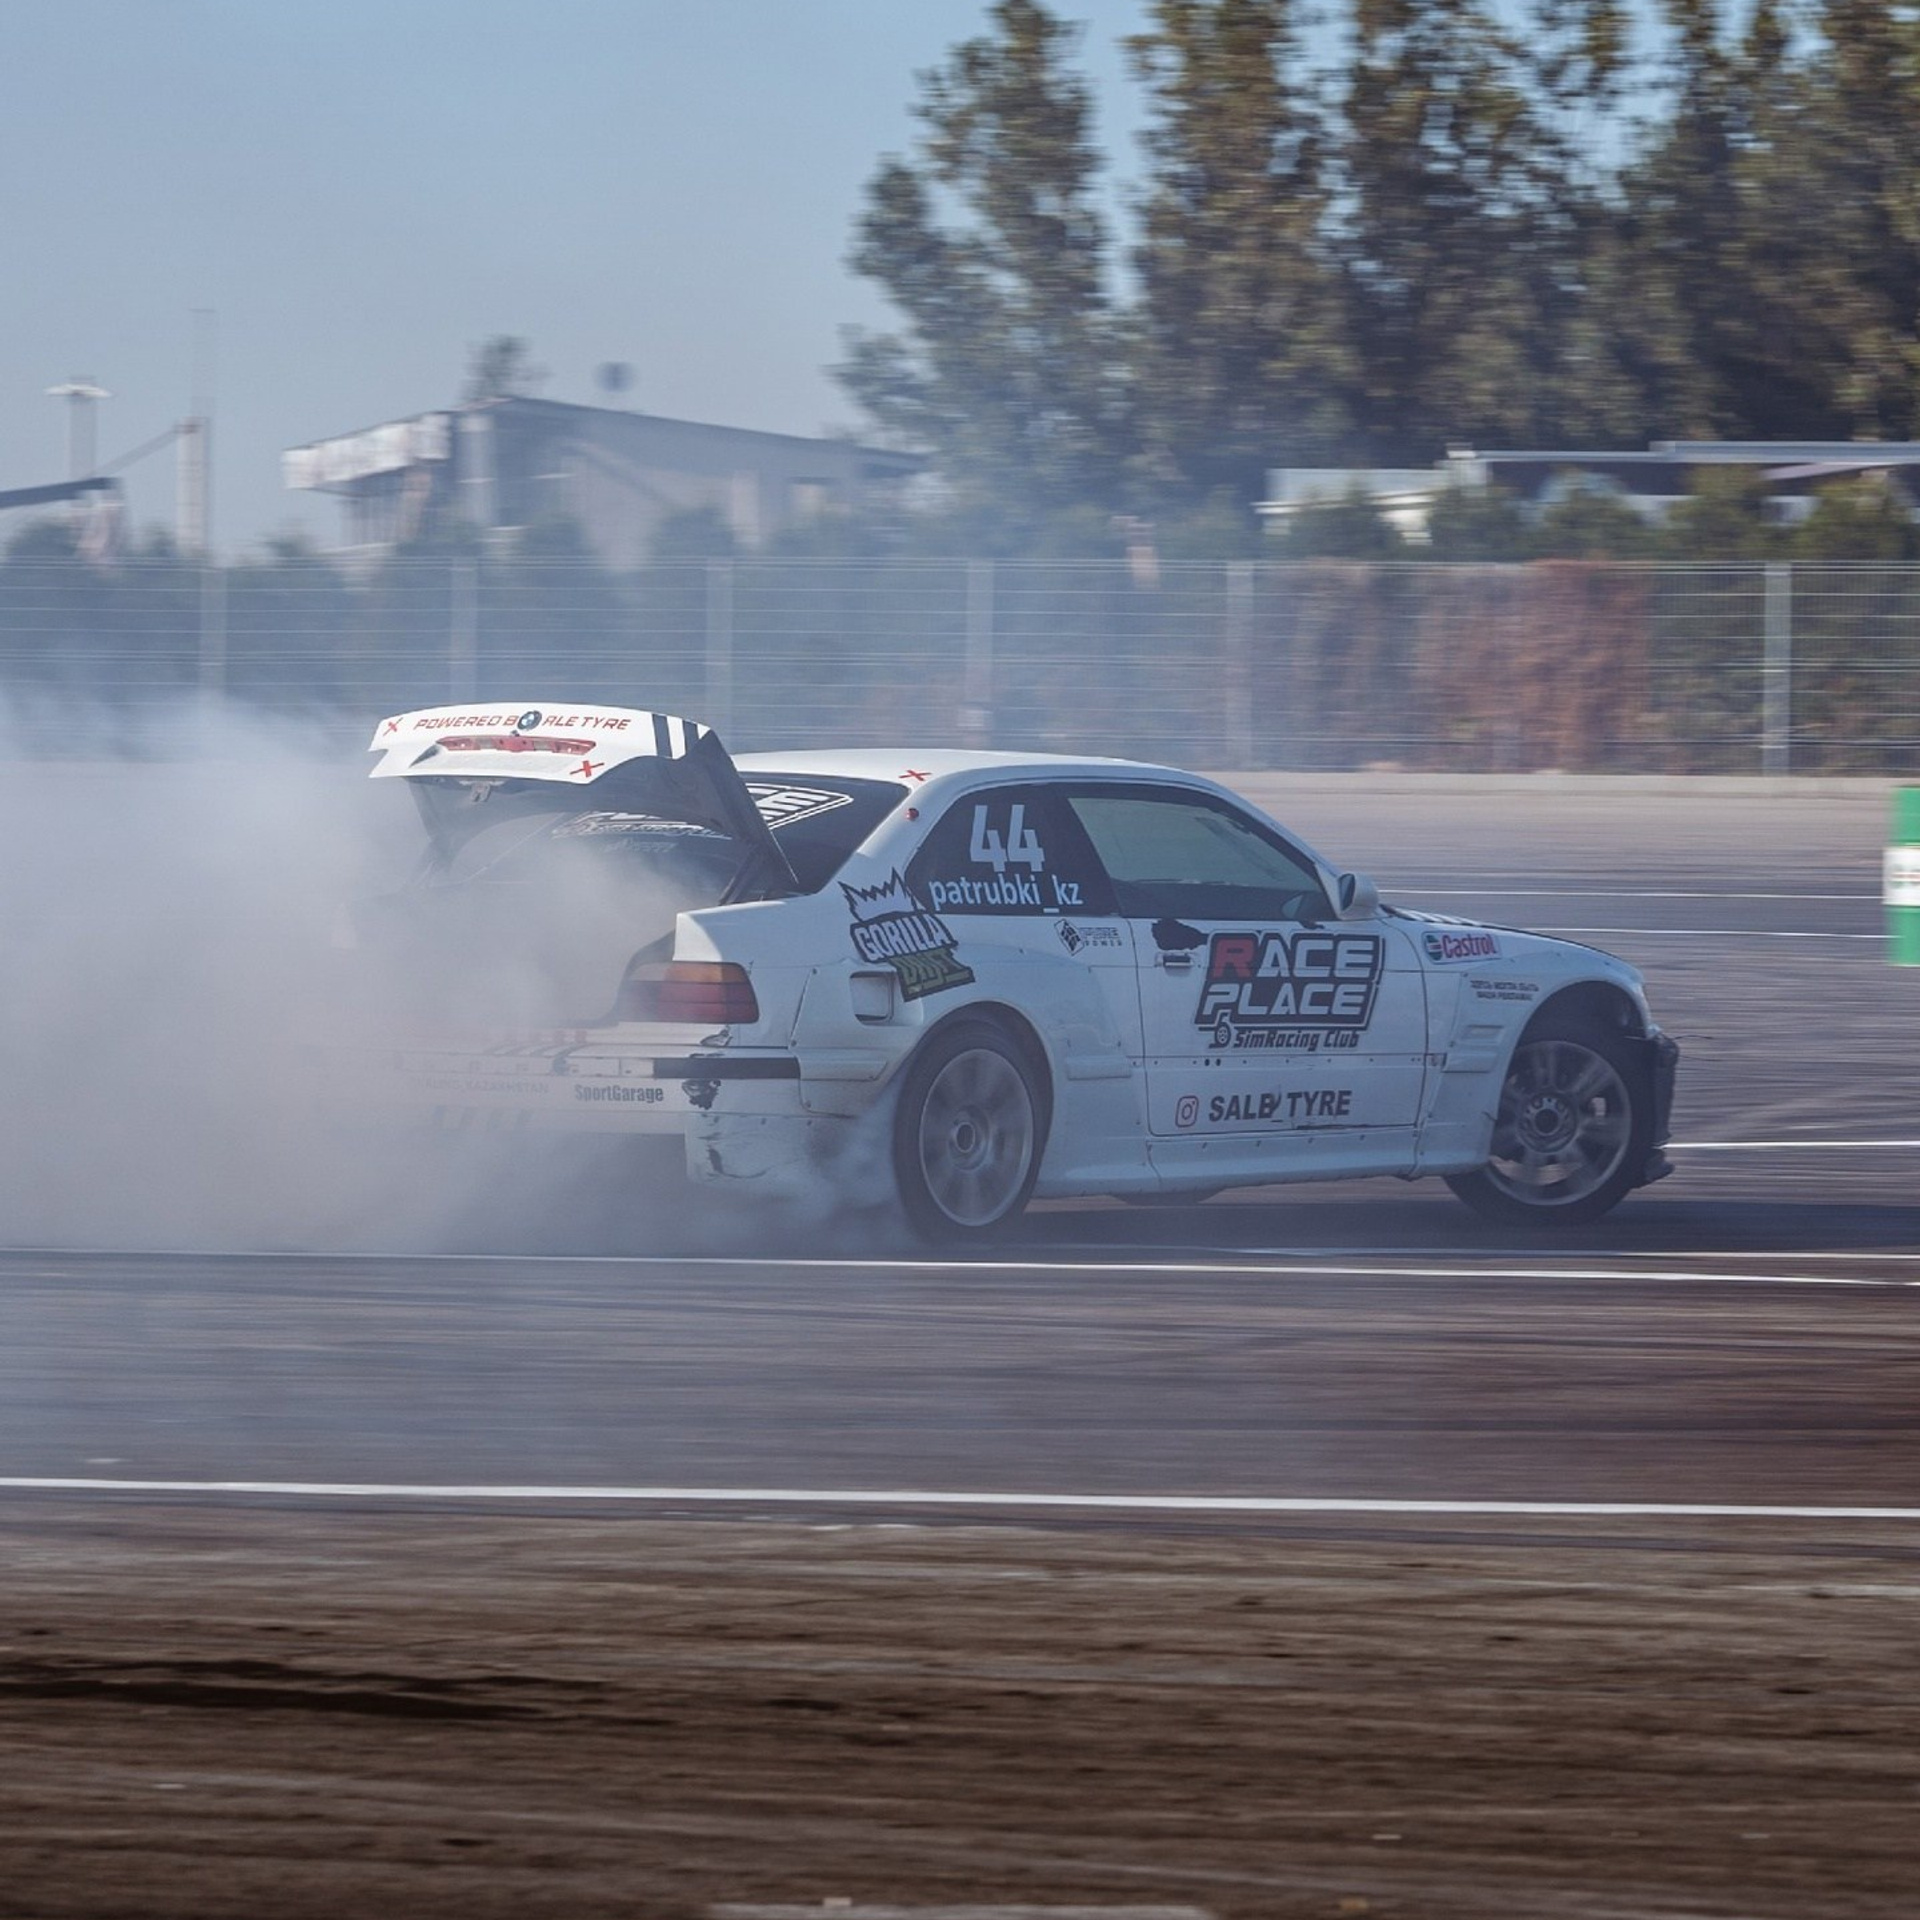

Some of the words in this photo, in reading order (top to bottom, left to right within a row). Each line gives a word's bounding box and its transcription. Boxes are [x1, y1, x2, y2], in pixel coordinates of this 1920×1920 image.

[413, 715, 502, 730] POWERED
[504, 714, 520, 726] B
[581, 715, 632, 731] TYRE
[969, 804, 1046, 872] 44
[854, 914, 951, 962] GORILLA
[1441, 933, 1498, 958] Castrol
[1211, 937, 1375, 979] RACE
[1202, 982, 1369, 1015] PLACE
[1233, 1029, 1320, 1051] SimRacing
[1323, 1030, 1360, 1048] Club
[574, 1084, 665, 1104] SportGarage
